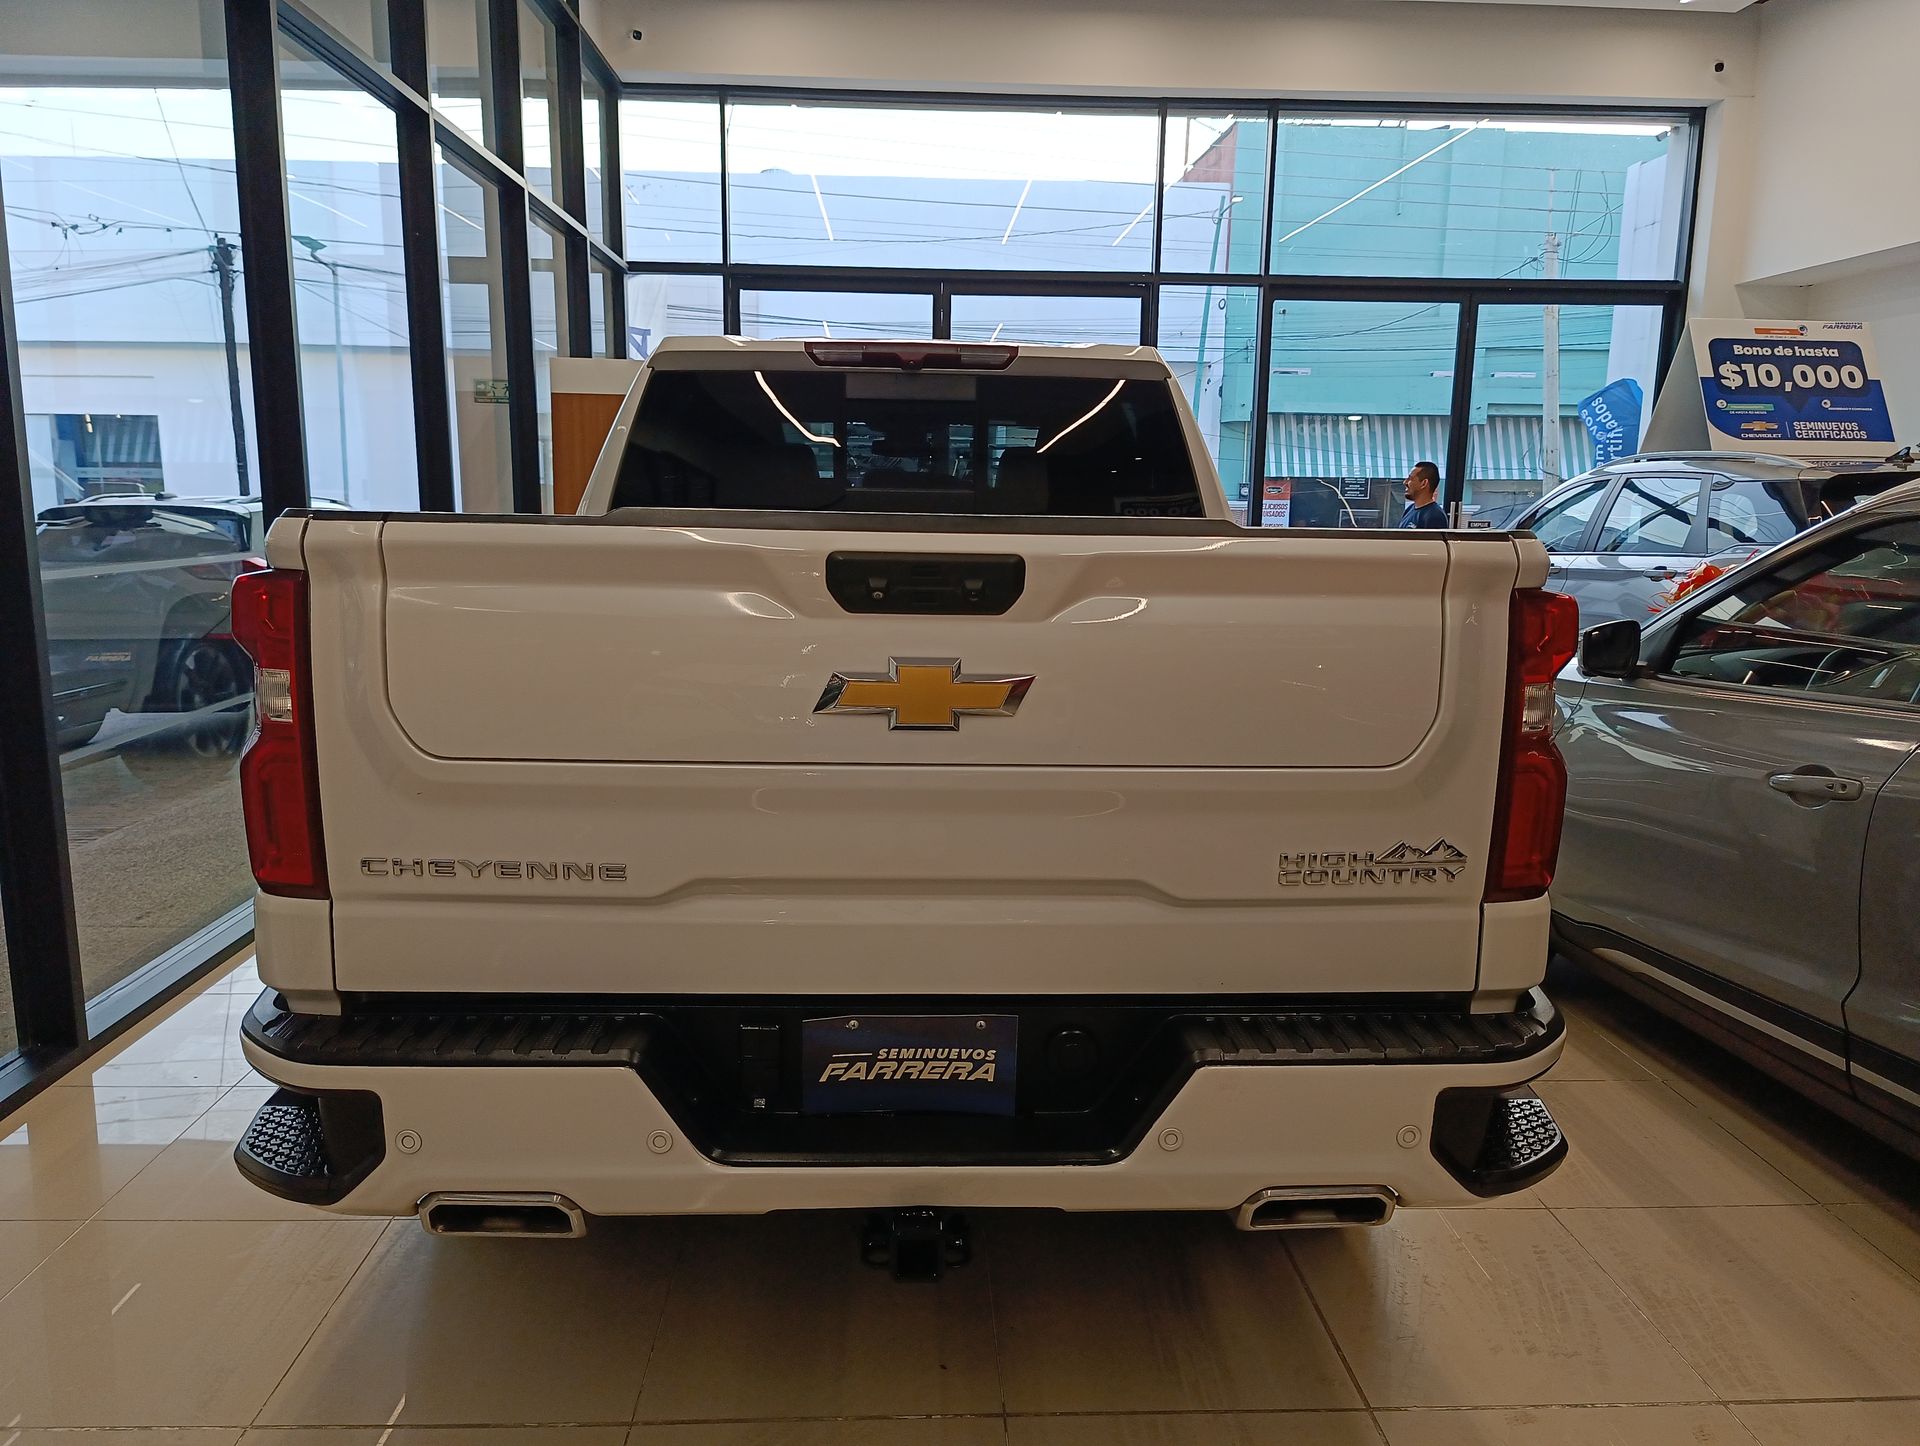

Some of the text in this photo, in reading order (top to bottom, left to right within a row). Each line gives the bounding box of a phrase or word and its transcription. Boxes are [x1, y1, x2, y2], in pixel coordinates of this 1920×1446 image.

[1733, 344, 1839, 358] Bono de hasta
[1718, 361, 1864, 392] $10,000
[1793, 421, 1859, 431] SEMINUEVOS
[1795, 430, 1867, 439] CERTIFICADOS
[1278, 852, 1375, 868] HIGH
[360, 857, 627, 881] CHEYENNE
[1277, 866, 1466, 887] COUNTRY
[877, 1048, 996, 1061] SEMINUEVOS
[819, 1061, 996, 1083] FARRERA
